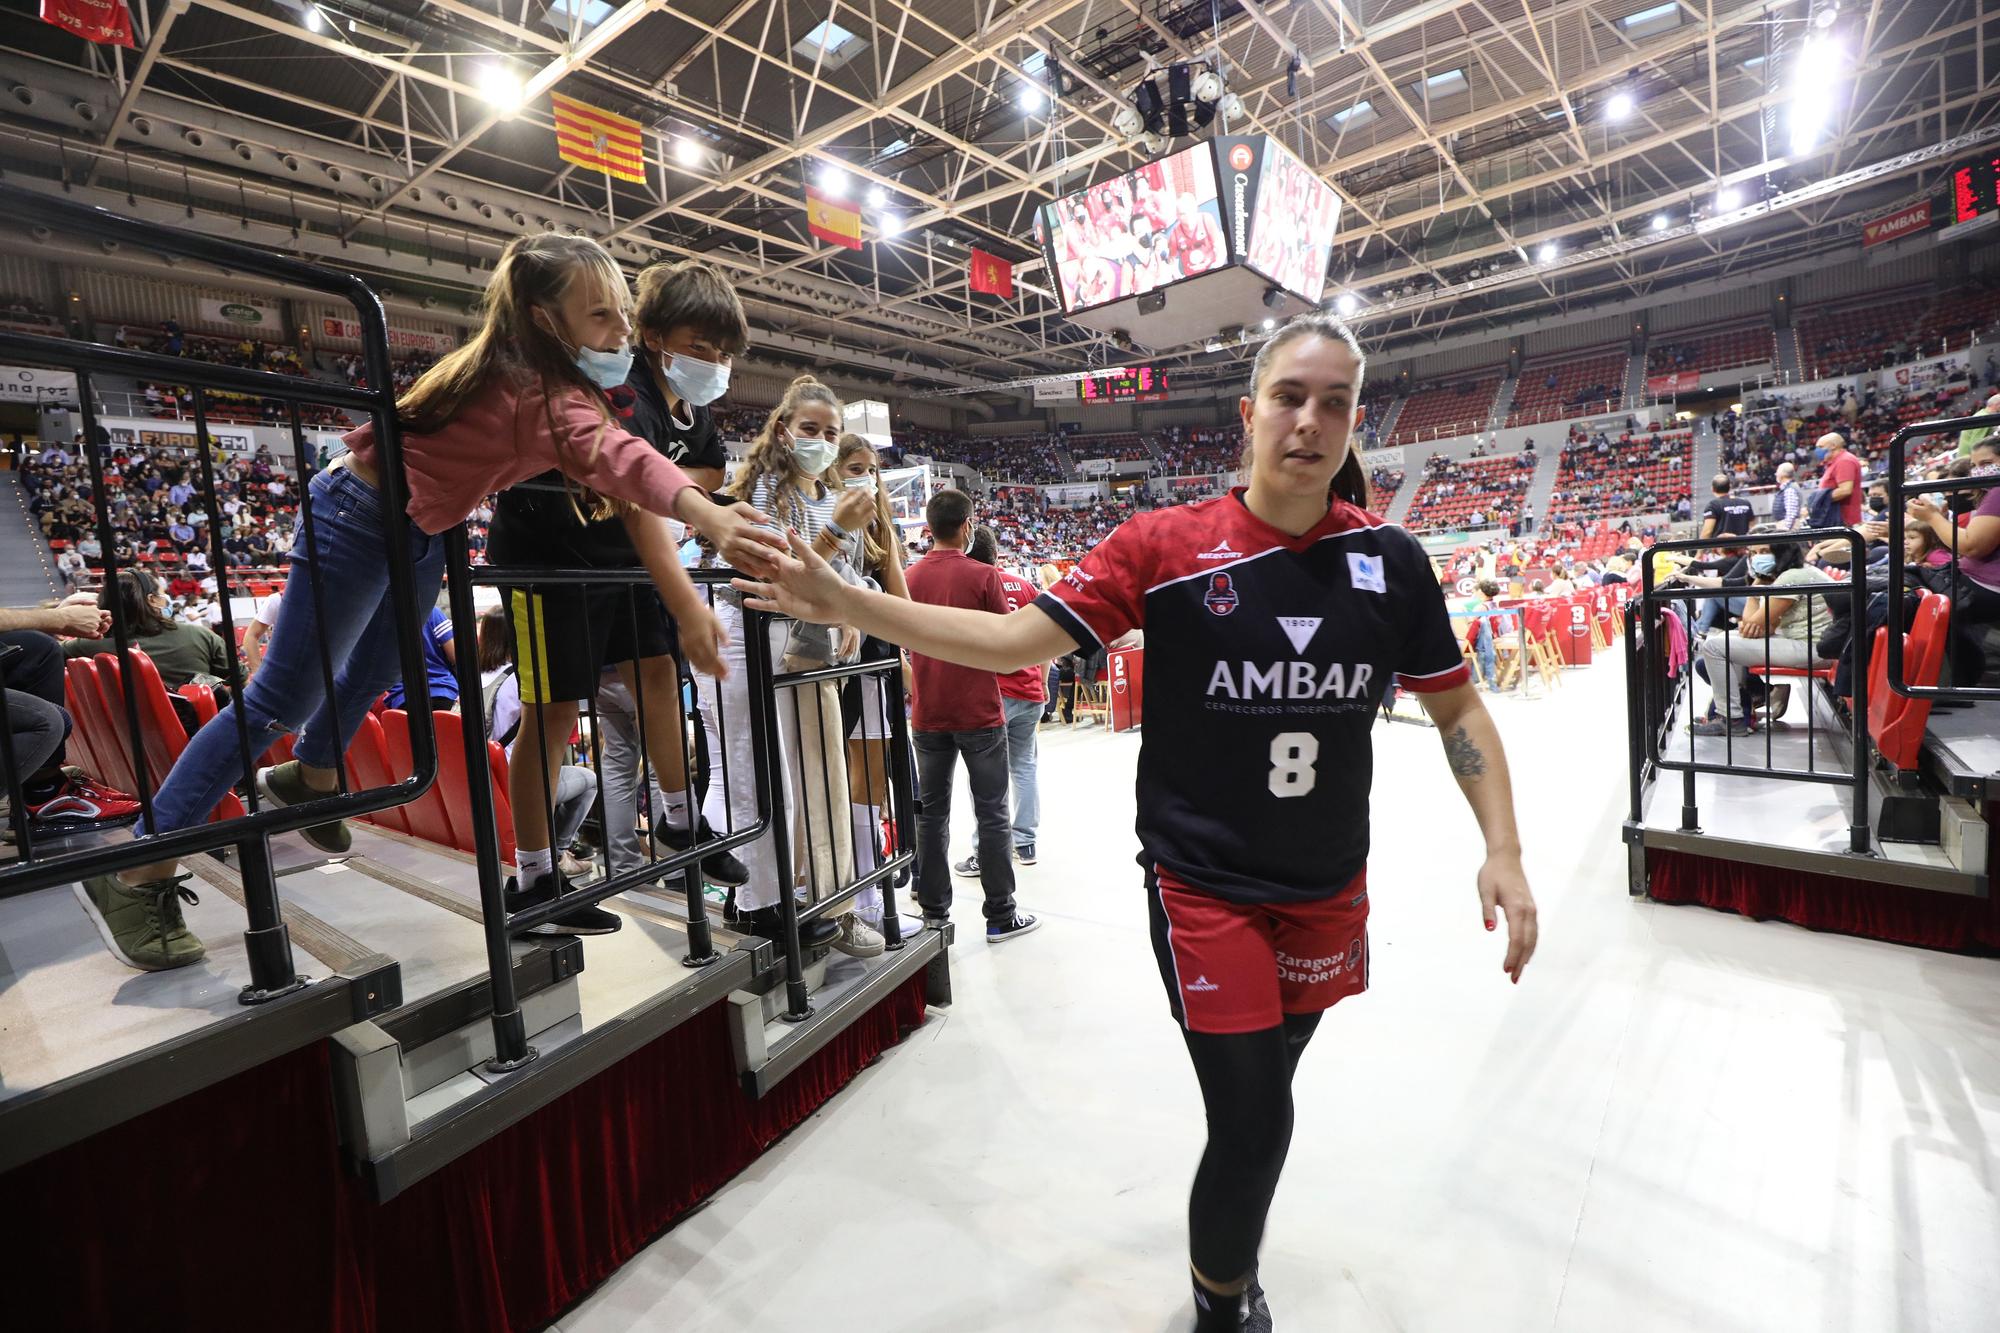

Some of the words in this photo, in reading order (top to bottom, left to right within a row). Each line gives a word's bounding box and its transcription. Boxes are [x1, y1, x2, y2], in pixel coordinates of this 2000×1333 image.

[1234, 172, 1249, 257] Casademont
[1879, 209, 1926, 235] AMBAR
[221, 436, 247, 450] FM
[1285, 619, 1316, 628] 1900
[1570, 605, 1586, 624] 3
[1114, 655, 1125, 677] 2
[1206, 660, 1374, 701] AMBAR
[1205, 701, 1283, 715] CERVECEROS
[1268, 732, 1320, 799] 8
[1276, 951, 1345, 972] Zaragoza
[1276, 965, 1343, 985] DEPORTE
